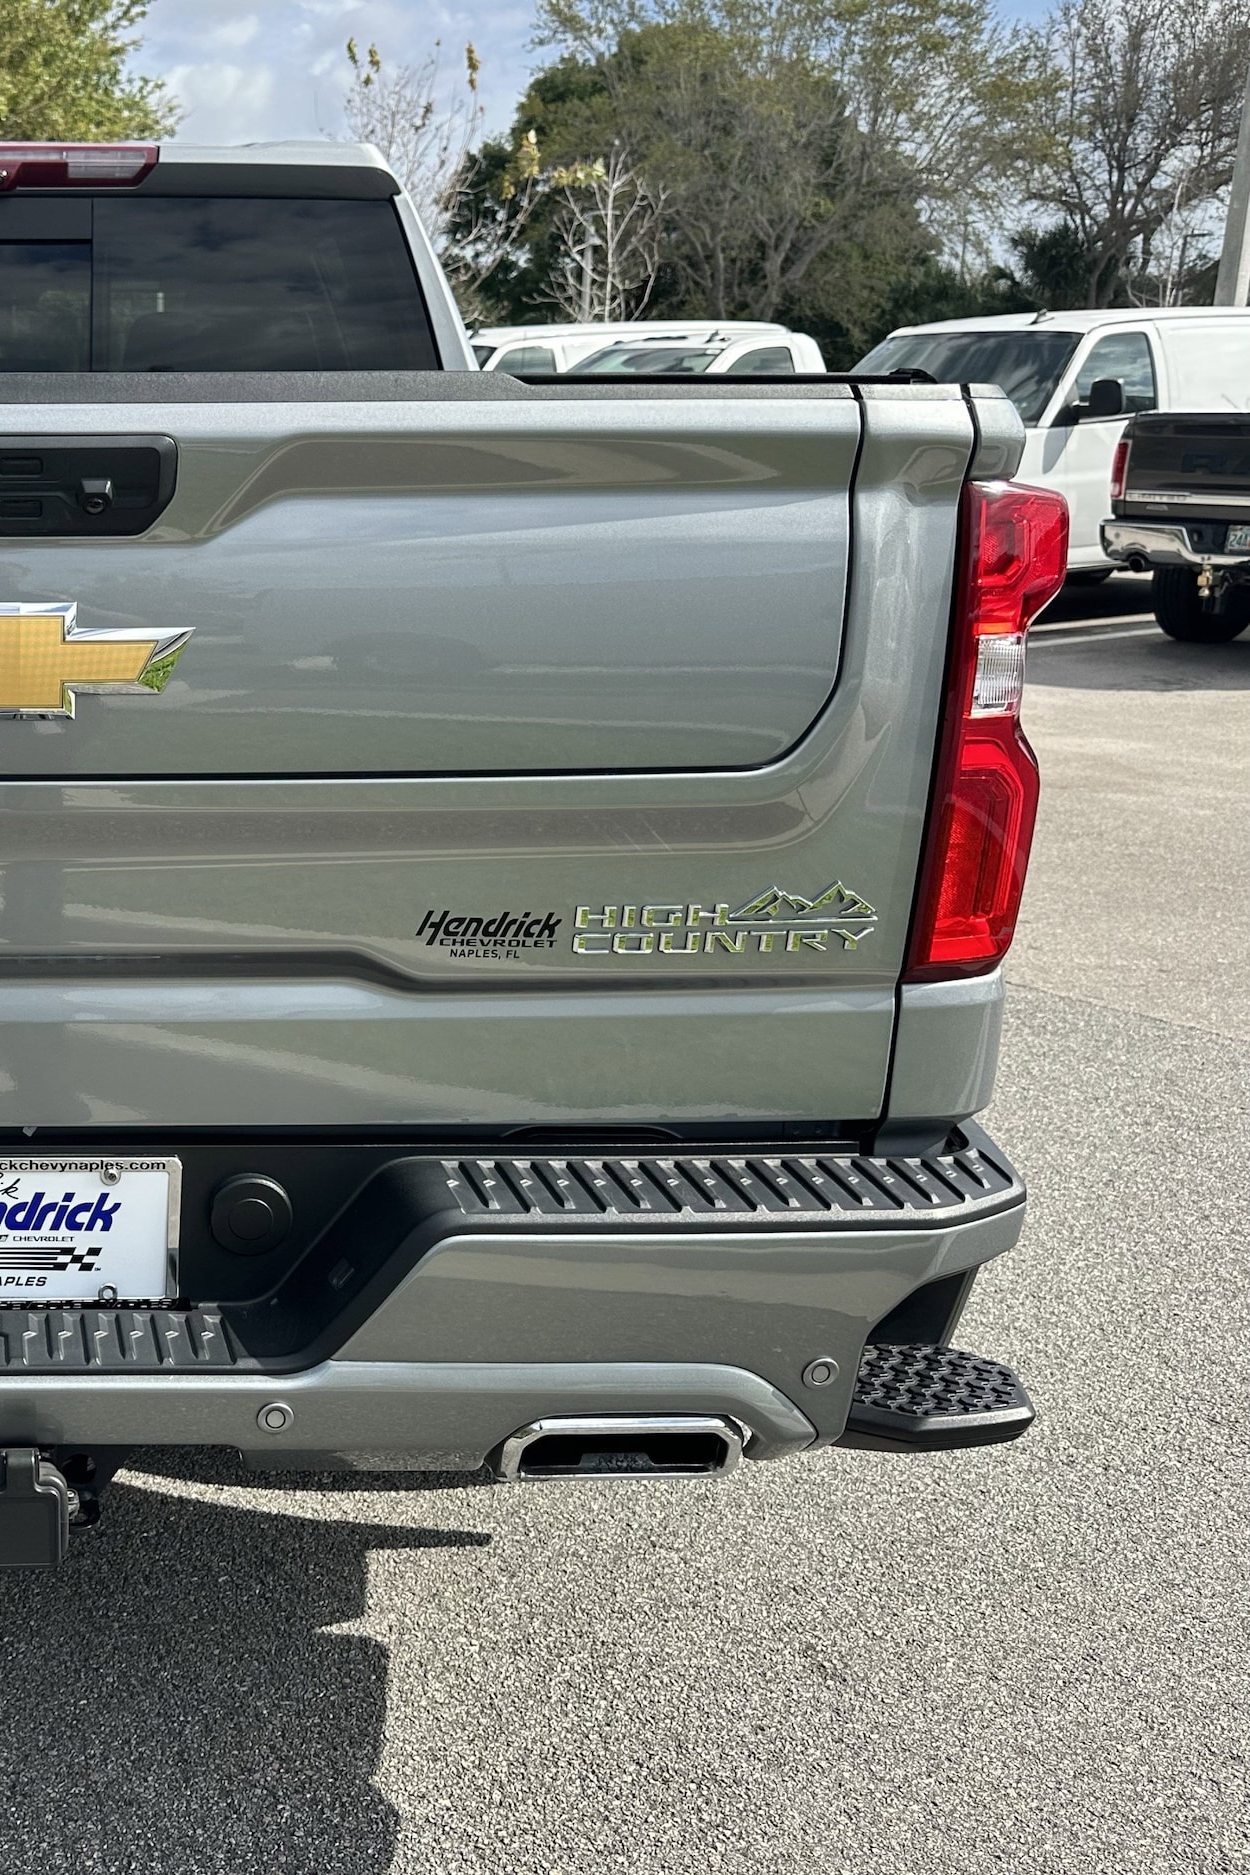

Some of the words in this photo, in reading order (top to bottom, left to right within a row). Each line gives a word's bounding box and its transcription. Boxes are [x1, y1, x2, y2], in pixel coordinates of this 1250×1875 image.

[573, 904, 731, 927] HIGH
[416, 910, 562, 946] Hendrick
[440, 938, 557, 948] CHEVROLET
[572, 928, 875, 954] COUNTRY
[450, 949, 501, 958] NAPLES,
[506, 949, 520, 958] FL
